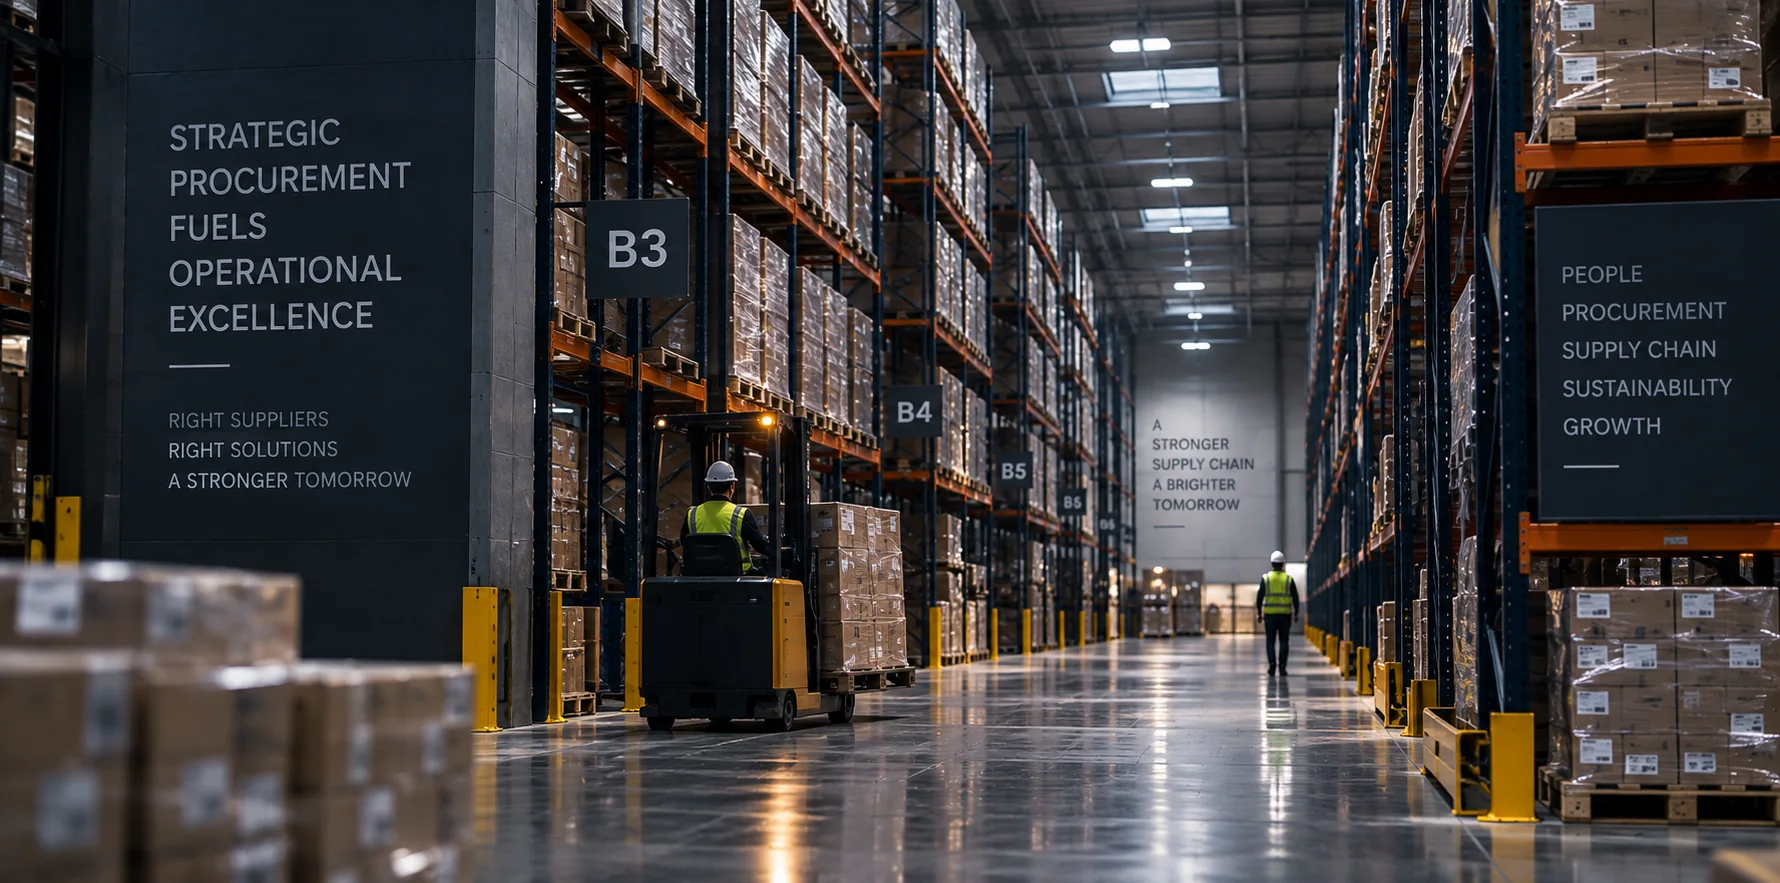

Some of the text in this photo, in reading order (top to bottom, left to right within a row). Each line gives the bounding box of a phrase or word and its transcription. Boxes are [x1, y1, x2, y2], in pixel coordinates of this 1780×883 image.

[170, 119, 340, 151] STRATEGIC
[171, 162, 411, 196] PROCUREMENT
[171, 212, 266, 241] FUELS
[609, 229, 668, 268] B3
[170, 255, 401, 286] OPERATIONAL
[1563, 265, 1642, 283] PEOPLE
[170, 301, 373, 332] EXCELLENCE
[1563, 302, 1726, 321] PROCUREMENT
[1563, 340, 1715, 359] SUPPLY CHAIN
[1563, 379, 1732, 397] SUSTAINABILITY
[170, 411, 328, 428] RIGHT SUPPLIERS
[897, 401, 933, 422] B4
[1152, 419, 1162, 431] A
[1564, 417, 1660, 435] GROWTH
[170, 441, 337, 458] RIGHT SOLUTIONS
[1152, 438, 1229, 450] STRONGER
[1001, 463, 1027, 480] B5
[1152, 458, 1254, 470] SUPPLY CHAIN
[168, 471, 411, 488] A STRONGER TOMORROW
[1152, 479, 1236, 491] A BRIGHTER
[1153, 499, 1240, 511] TOMORROW
